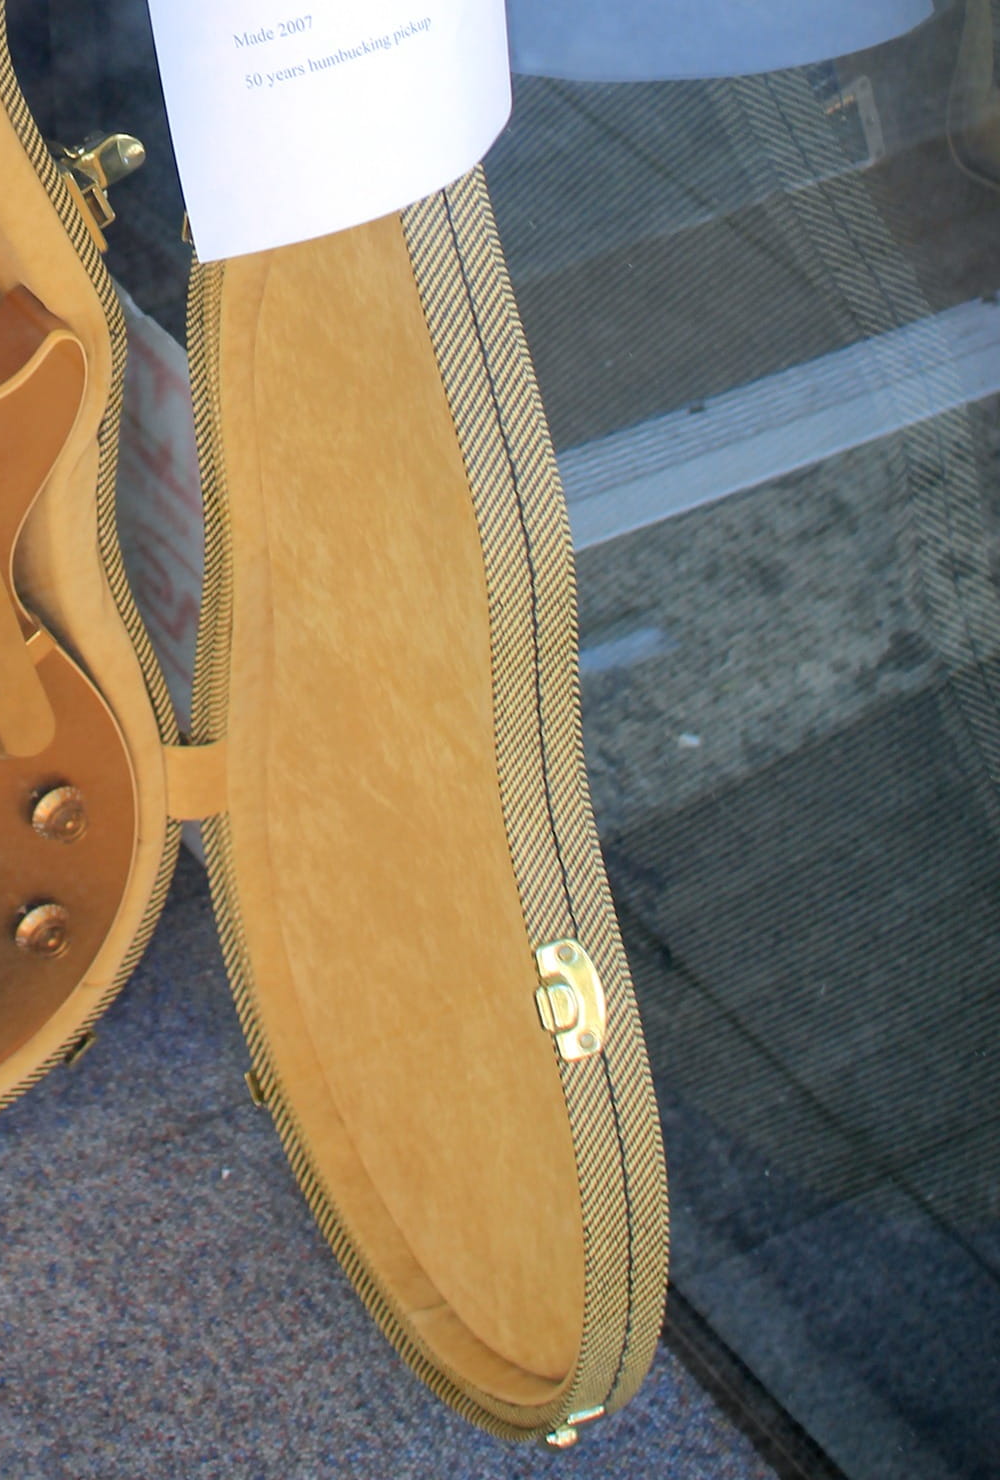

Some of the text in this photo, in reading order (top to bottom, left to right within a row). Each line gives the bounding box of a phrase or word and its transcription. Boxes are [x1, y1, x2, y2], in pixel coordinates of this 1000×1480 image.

[233, 15, 313, 49] Made 2007
[245, 16, 433, 90] 50 years humbucking pickup
